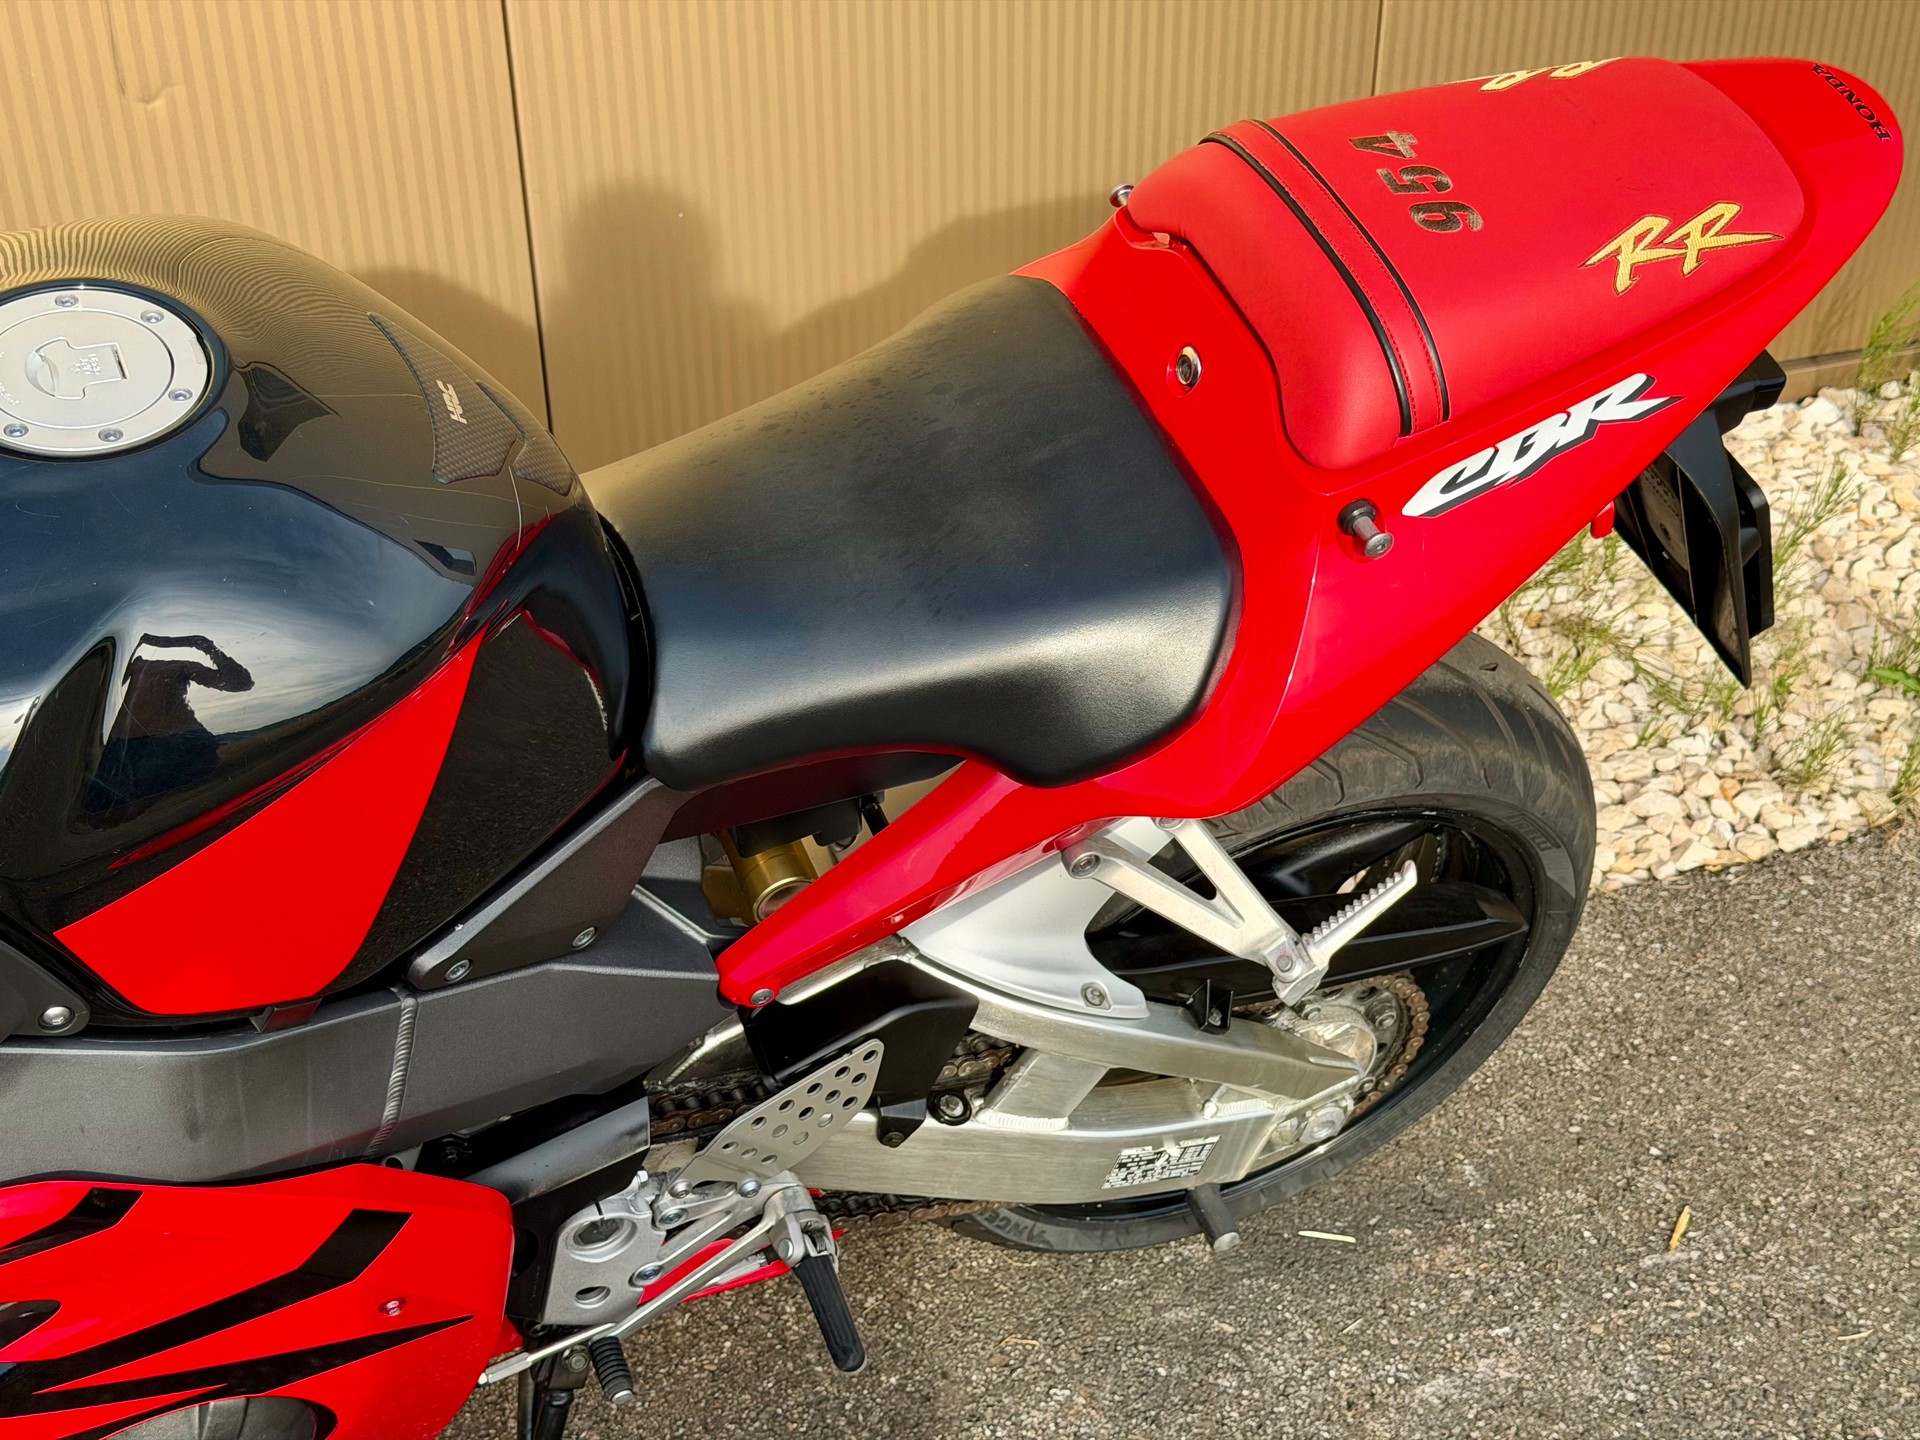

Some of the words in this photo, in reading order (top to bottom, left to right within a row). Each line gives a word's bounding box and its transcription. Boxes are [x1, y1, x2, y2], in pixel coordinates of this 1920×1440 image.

[1813, 64, 1892, 141] HONDA
[1349, 131, 1484, 233] 954
[1579, 202, 1784, 295] RR
[436, 379, 468, 425] HRC
[1402, 373, 1685, 517] CBR
